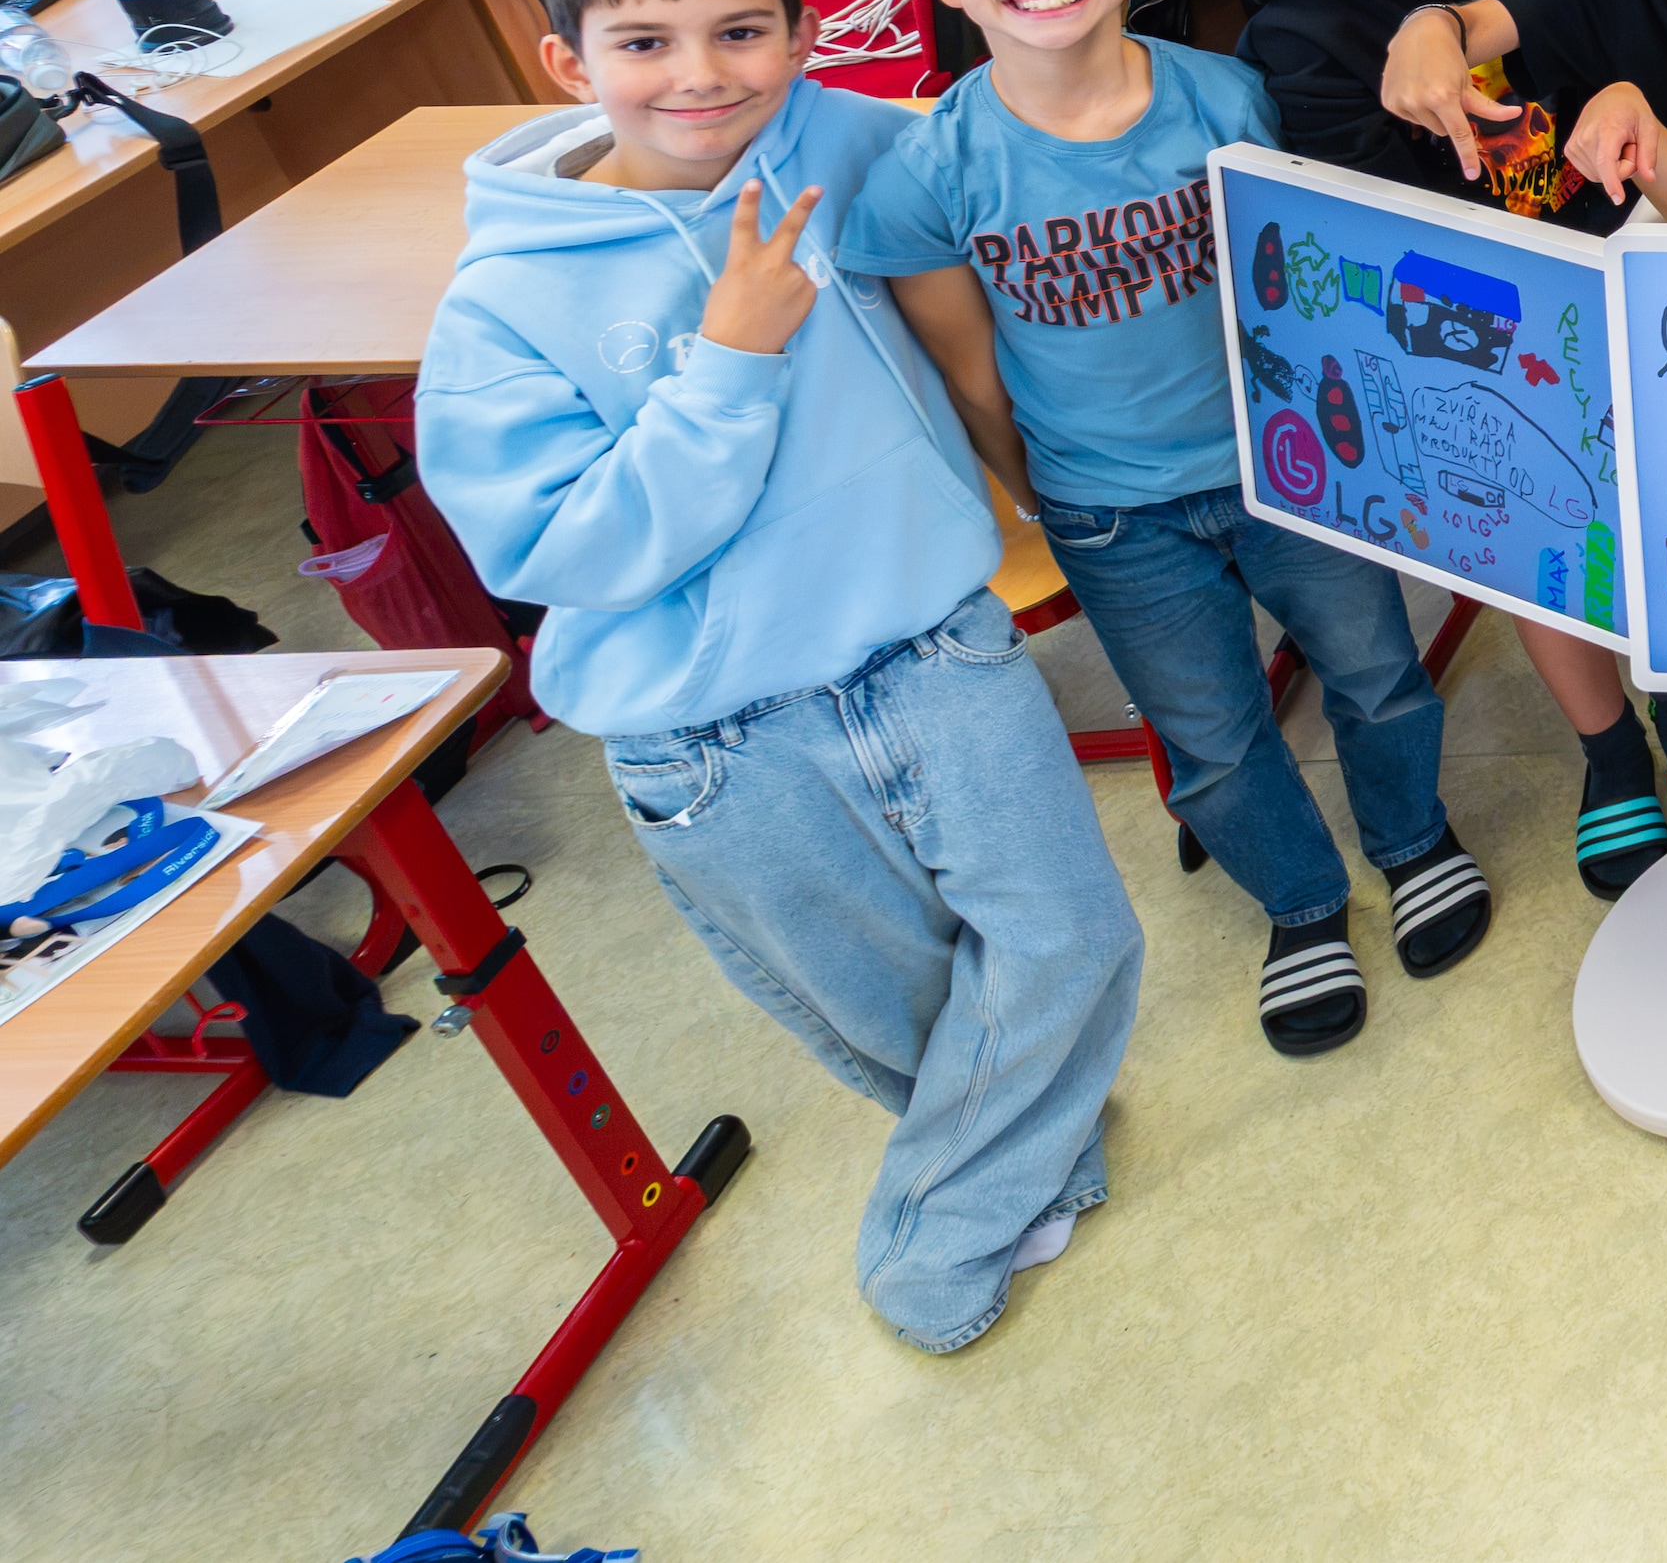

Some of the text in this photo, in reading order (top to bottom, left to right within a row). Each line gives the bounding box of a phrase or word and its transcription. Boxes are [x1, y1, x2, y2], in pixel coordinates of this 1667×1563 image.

[1336, 481, 1398, 539] LG
[1509, 466, 1535, 497] OD
[1548, 484, 1589, 520] LG
[1548, 550, 1569, 610] MAX
